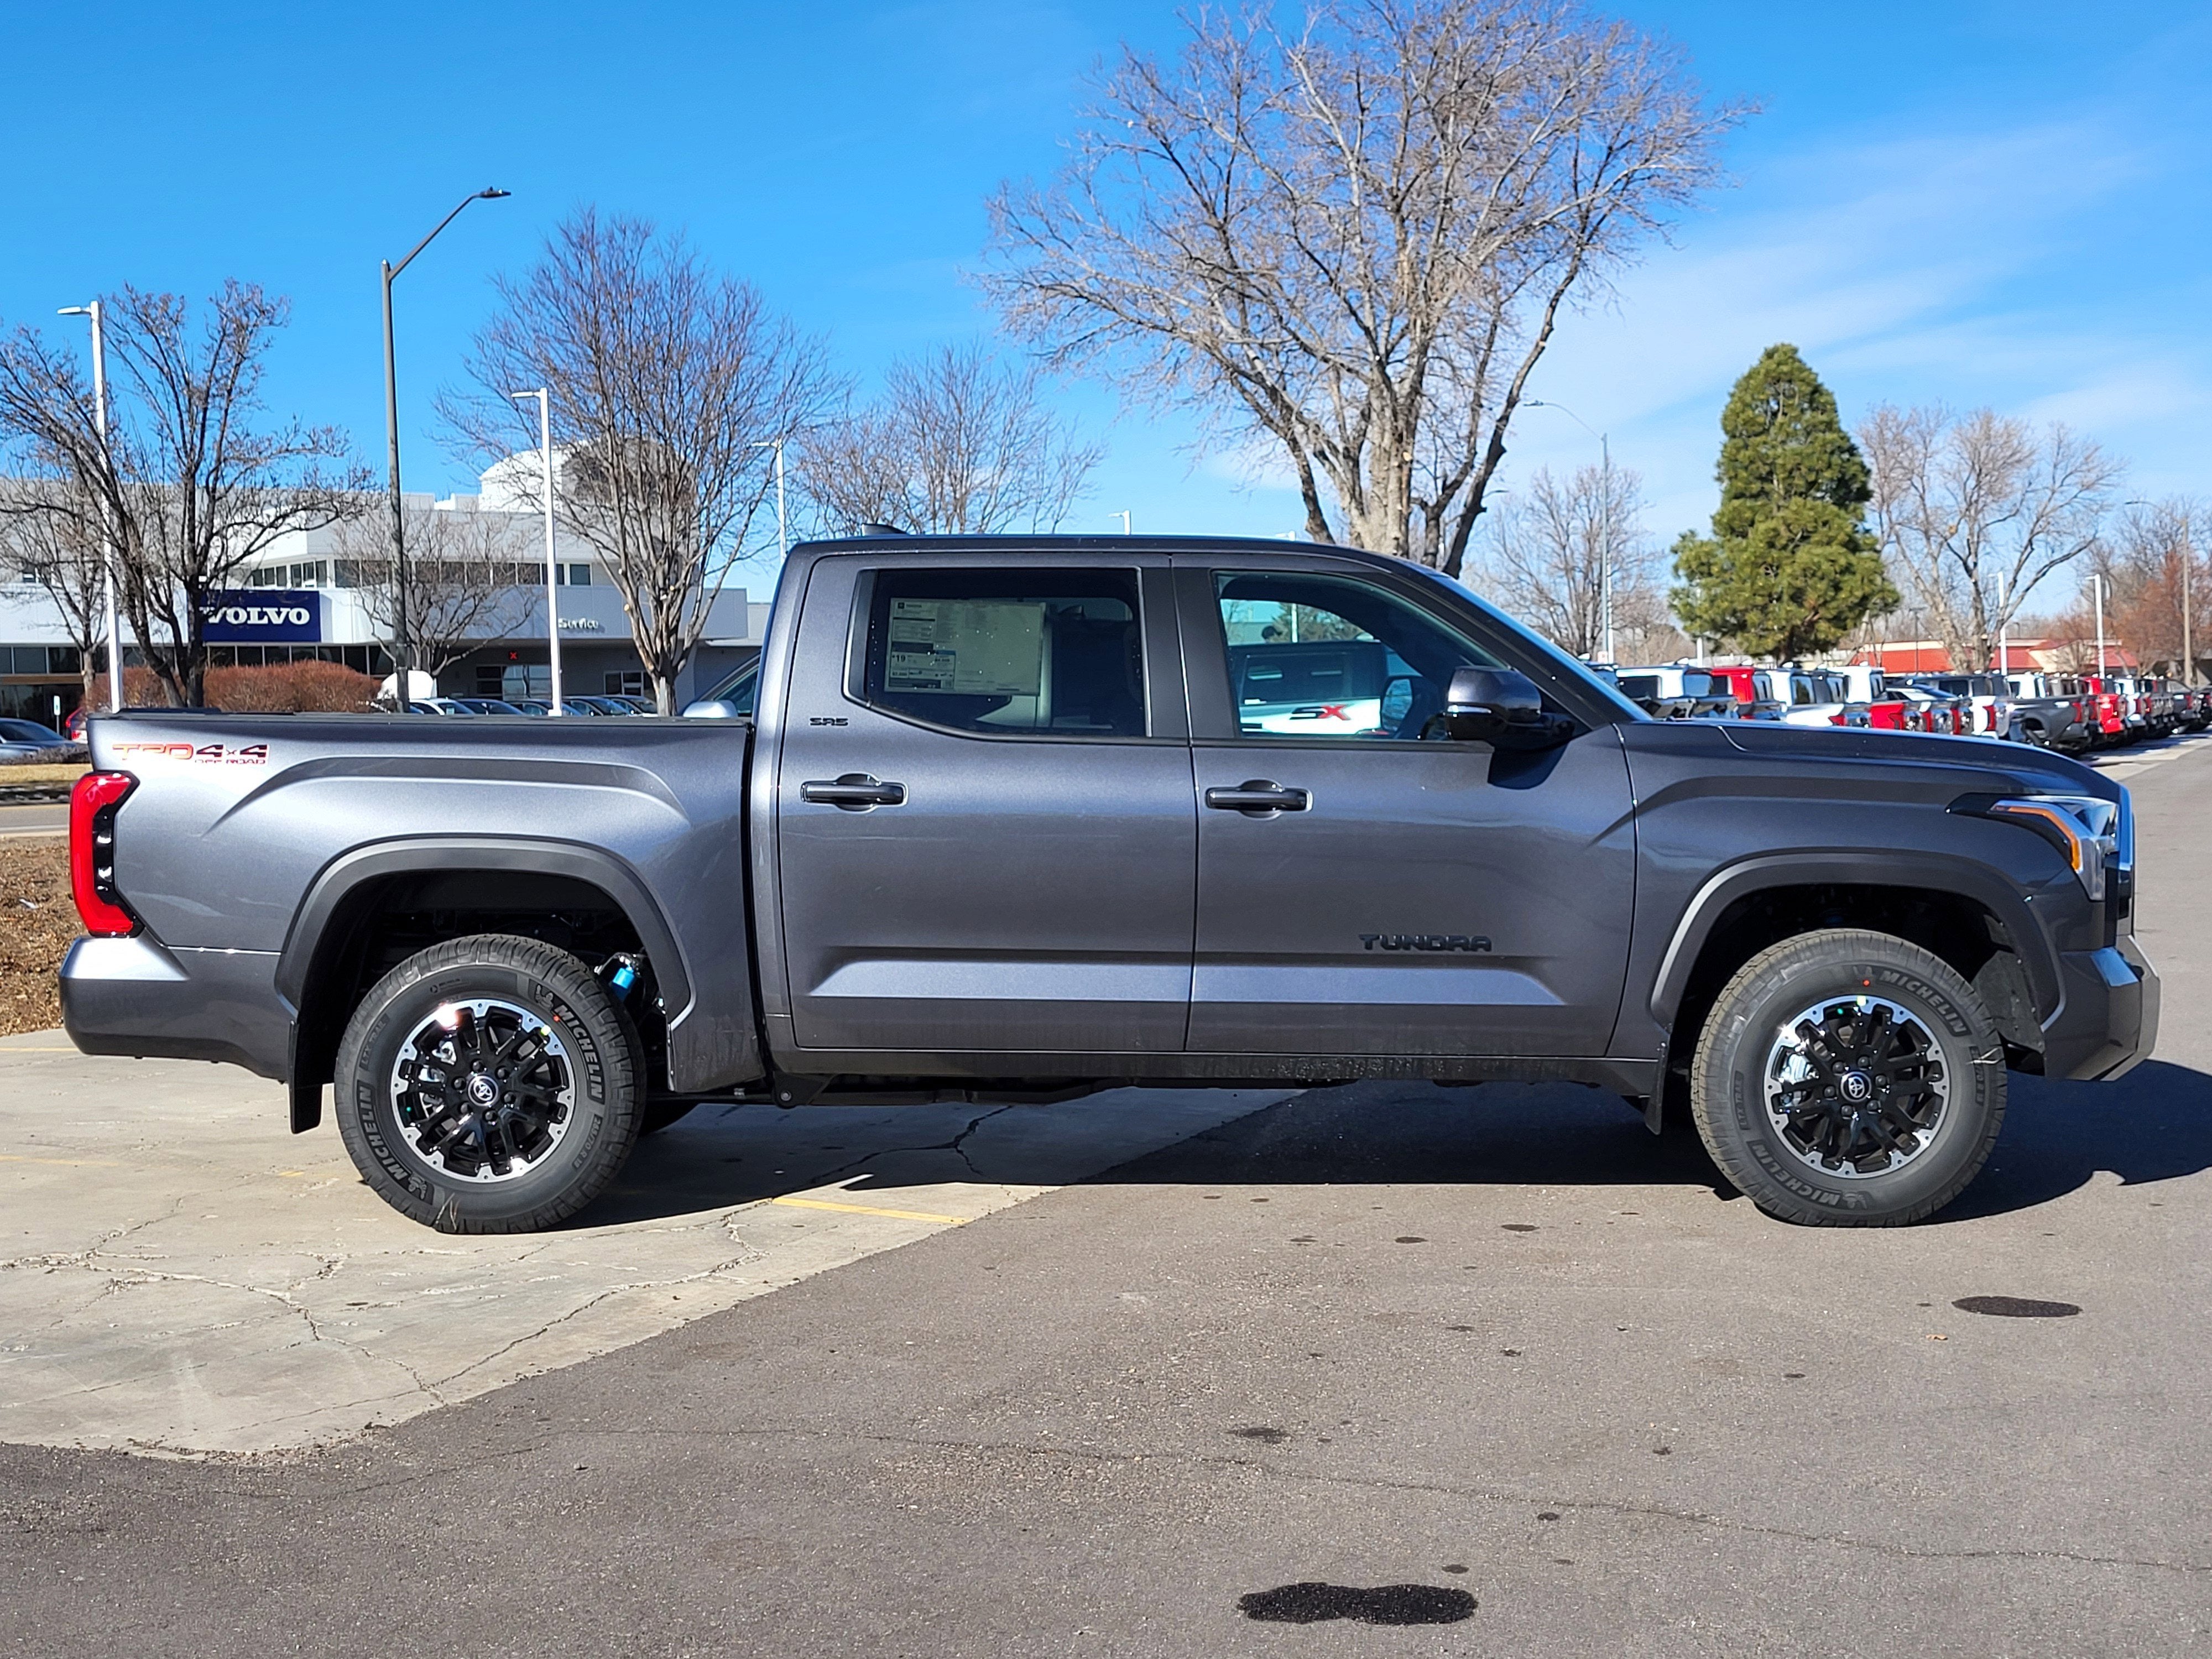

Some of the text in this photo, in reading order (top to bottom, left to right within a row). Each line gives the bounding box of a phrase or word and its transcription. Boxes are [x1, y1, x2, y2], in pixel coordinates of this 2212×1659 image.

[199, 607, 310, 625] VOLVO
[112, 744, 194, 760] TRD
[1358, 933, 1492, 952] TUNDRA
[1880, 969, 1966, 1035] MICHELIN
[554, 1002, 602, 1098] MICHELIN
[360, 1088, 406, 1179] MICHELIN
[1752, 1142, 1840, 1206] MICHELIN
